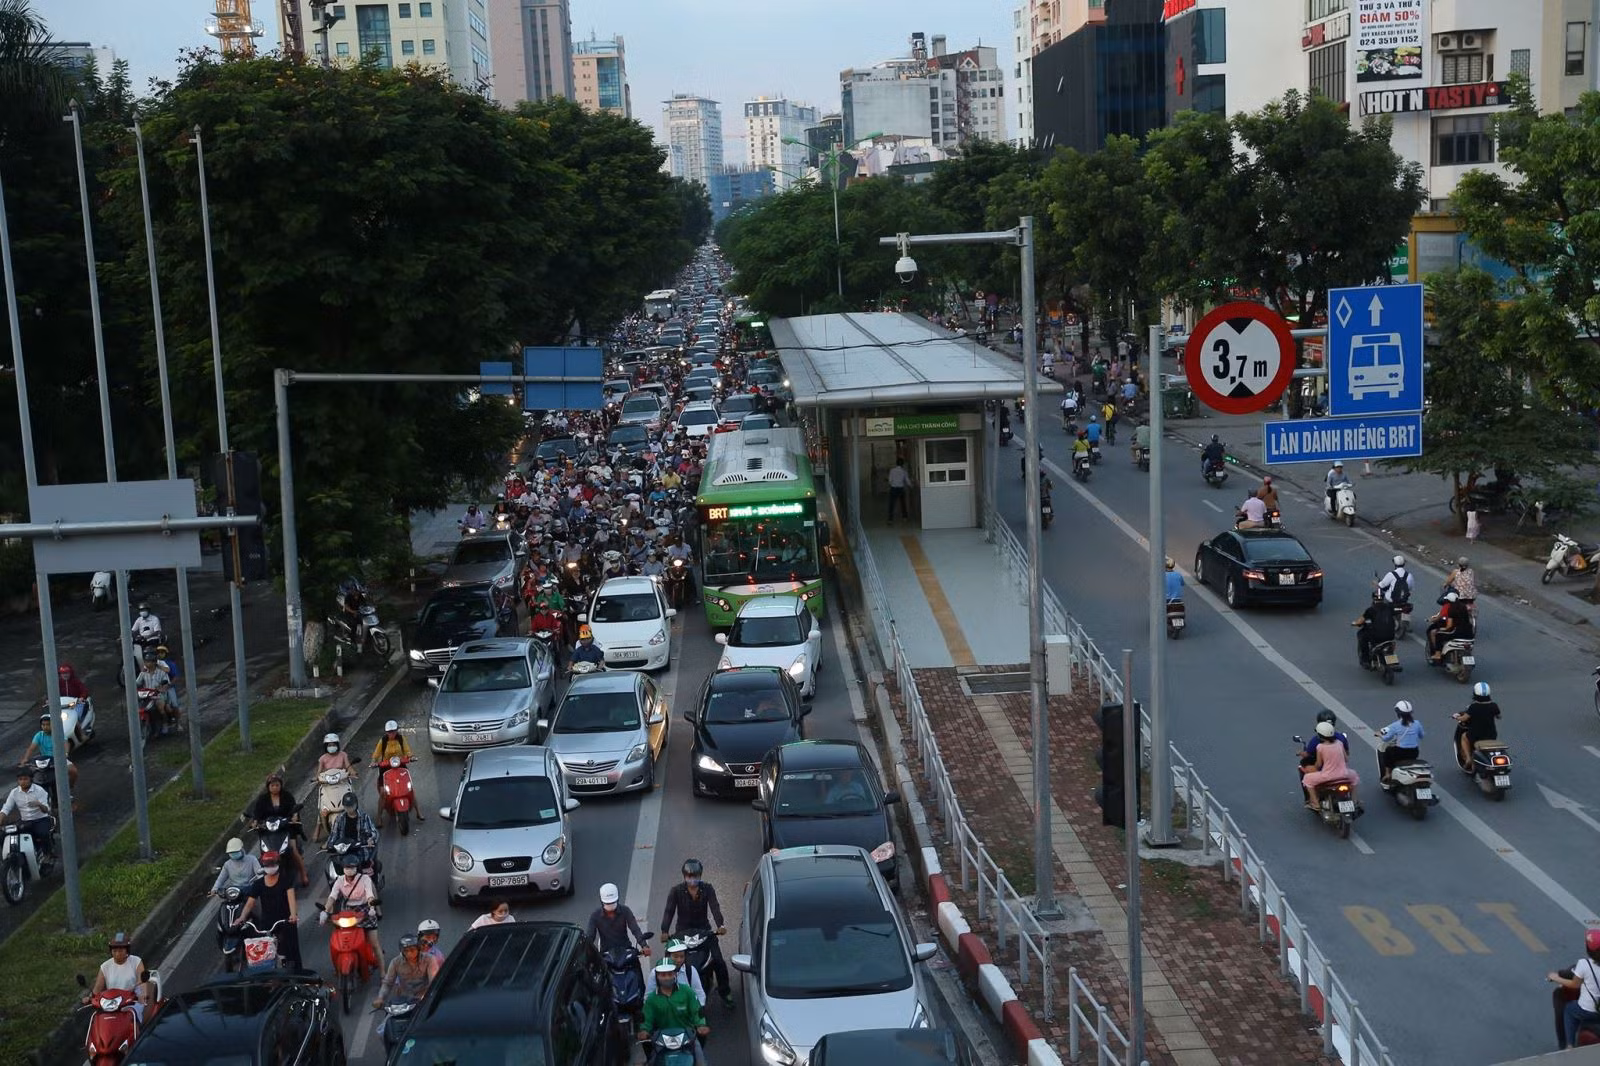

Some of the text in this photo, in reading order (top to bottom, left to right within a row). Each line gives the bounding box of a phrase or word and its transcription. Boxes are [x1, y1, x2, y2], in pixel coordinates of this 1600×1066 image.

[1394, 10, 1420, 21] 50%
[1360, 38, 1376, 46] 024
[1401, 35, 1419, 43] 1152
[1426, 84, 1486, 110] TASTY
[1271, 423, 1416, 456] LÀN DÀNH RIÊNG BRT
[709, 507, 728, 520] BRT
[1343, 903, 1550, 956] BRT
